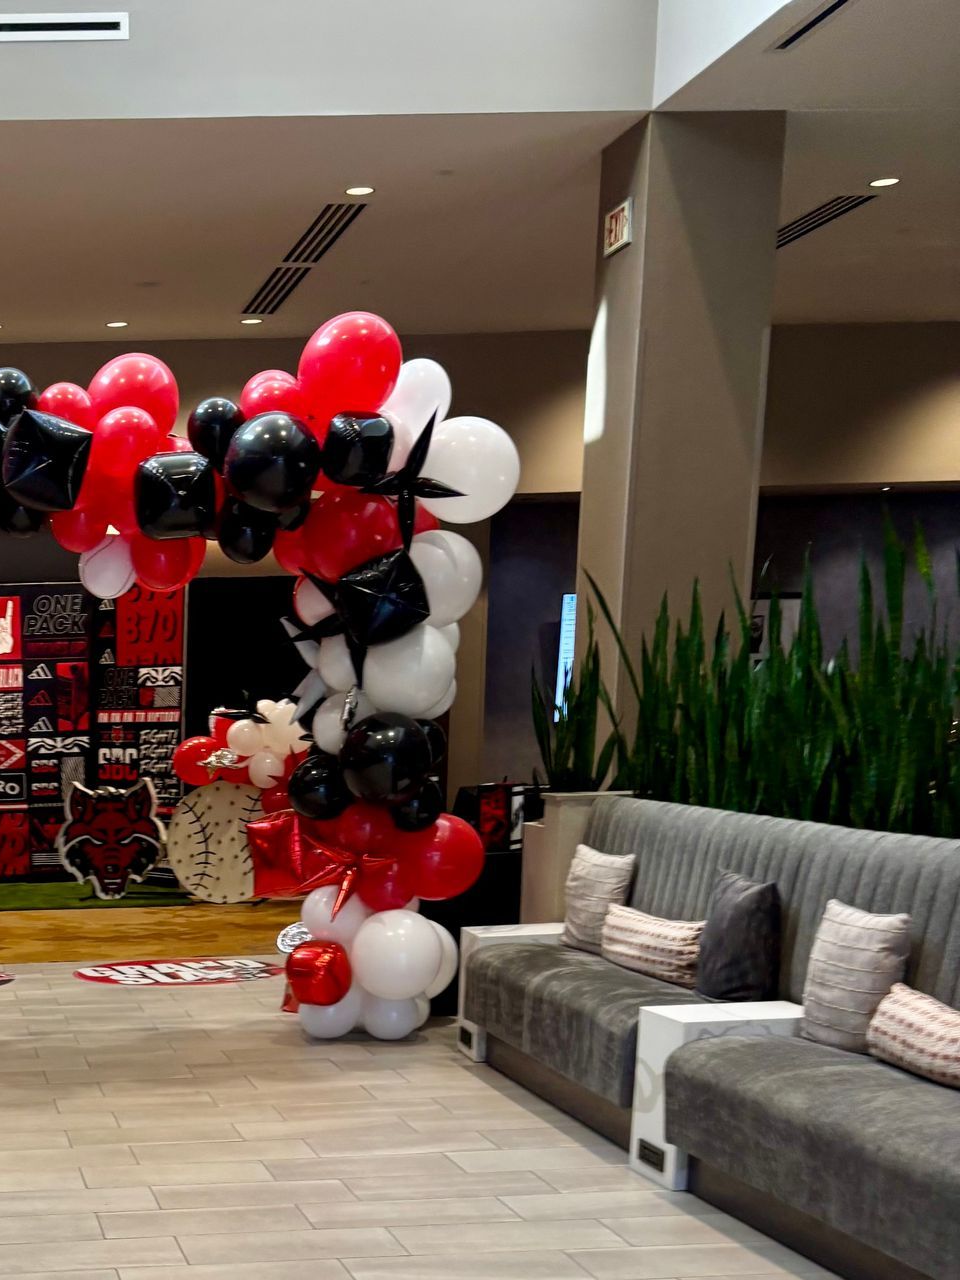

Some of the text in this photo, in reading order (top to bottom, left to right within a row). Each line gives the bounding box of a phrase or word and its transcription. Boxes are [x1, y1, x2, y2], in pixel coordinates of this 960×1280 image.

[33, 594, 82, 615] ONE
[24, 613, 88, 635] PACK
[77, 959, 266, 977] GRAND
